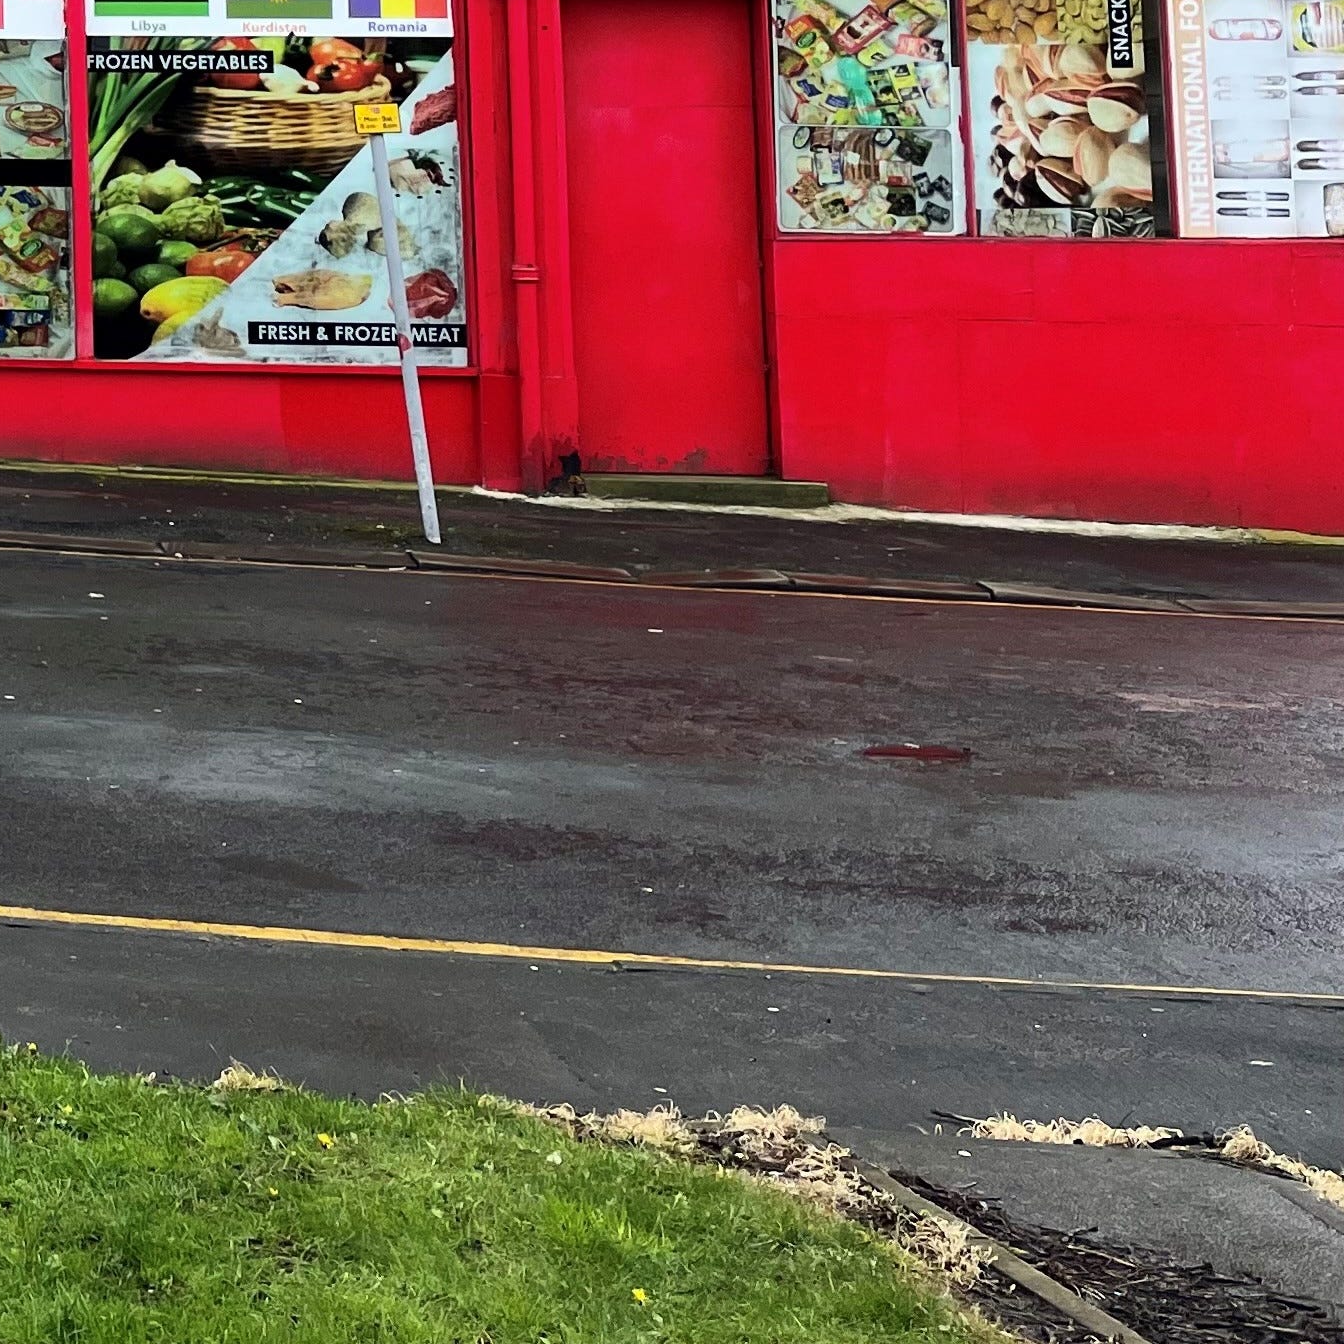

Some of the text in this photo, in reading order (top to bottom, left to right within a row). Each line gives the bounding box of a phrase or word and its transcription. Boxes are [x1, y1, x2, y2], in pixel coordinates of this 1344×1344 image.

[131, 20, 167, 33] Libya
[242, 21, 307, 33] Kurdistan
[368, 21, 428, 33] Romania
[87, 55, 268, 70] FROZEN VEGETABLES
[1181, 36, 1211, 228] INTERNATIONAL
[258, 325, 461, 343] FRESH & FROZEN MEAT
